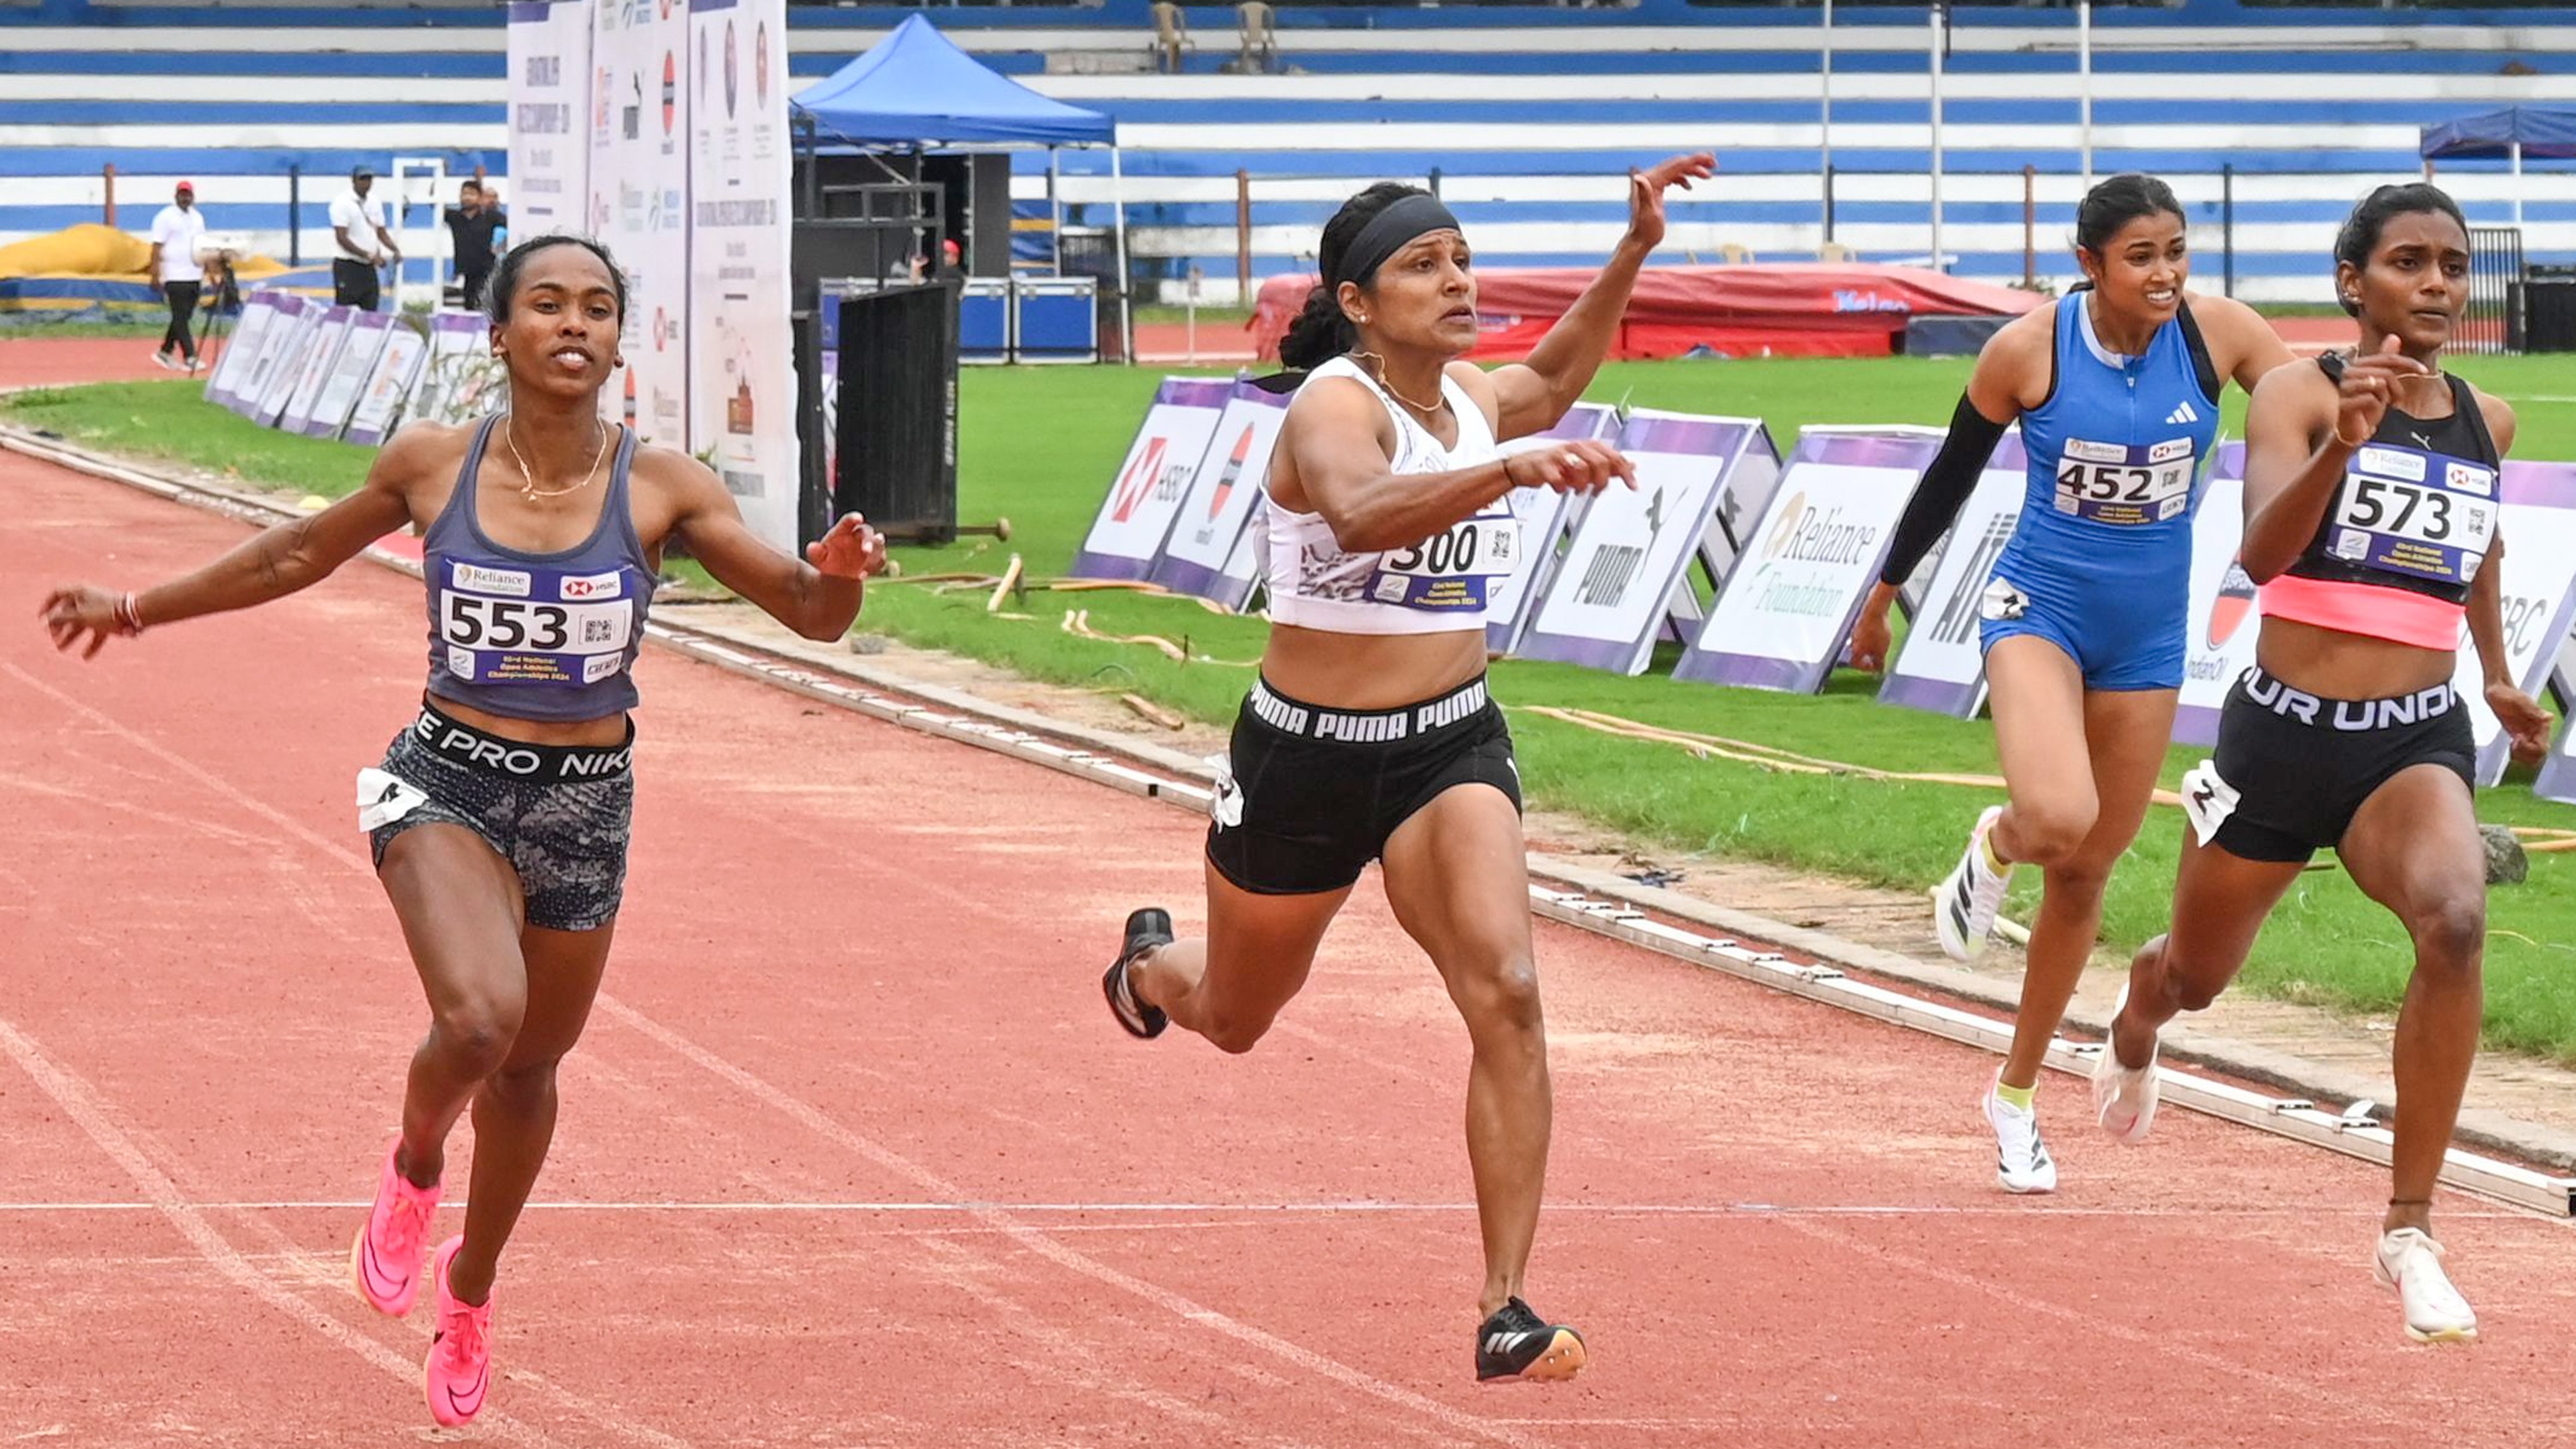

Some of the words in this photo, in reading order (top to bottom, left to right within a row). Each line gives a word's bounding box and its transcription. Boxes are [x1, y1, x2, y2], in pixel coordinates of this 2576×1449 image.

[2058, 465, 2153, 502] 452
[2348, 480, 2452, 540] 573
[1782, 506, 1876, 565] Reliance
[473, 568, 525, 586] Reliance
[1755, 571, 1844, 617] Foundation
[449, 596, 568, 649] 553
[1251, 681, 1309, 736] PUMA
[1313, 712, 1408, 742] PUMA
[1416, 681, 1486, 734] PUMA
[439, 728, 541, 775] PRO
